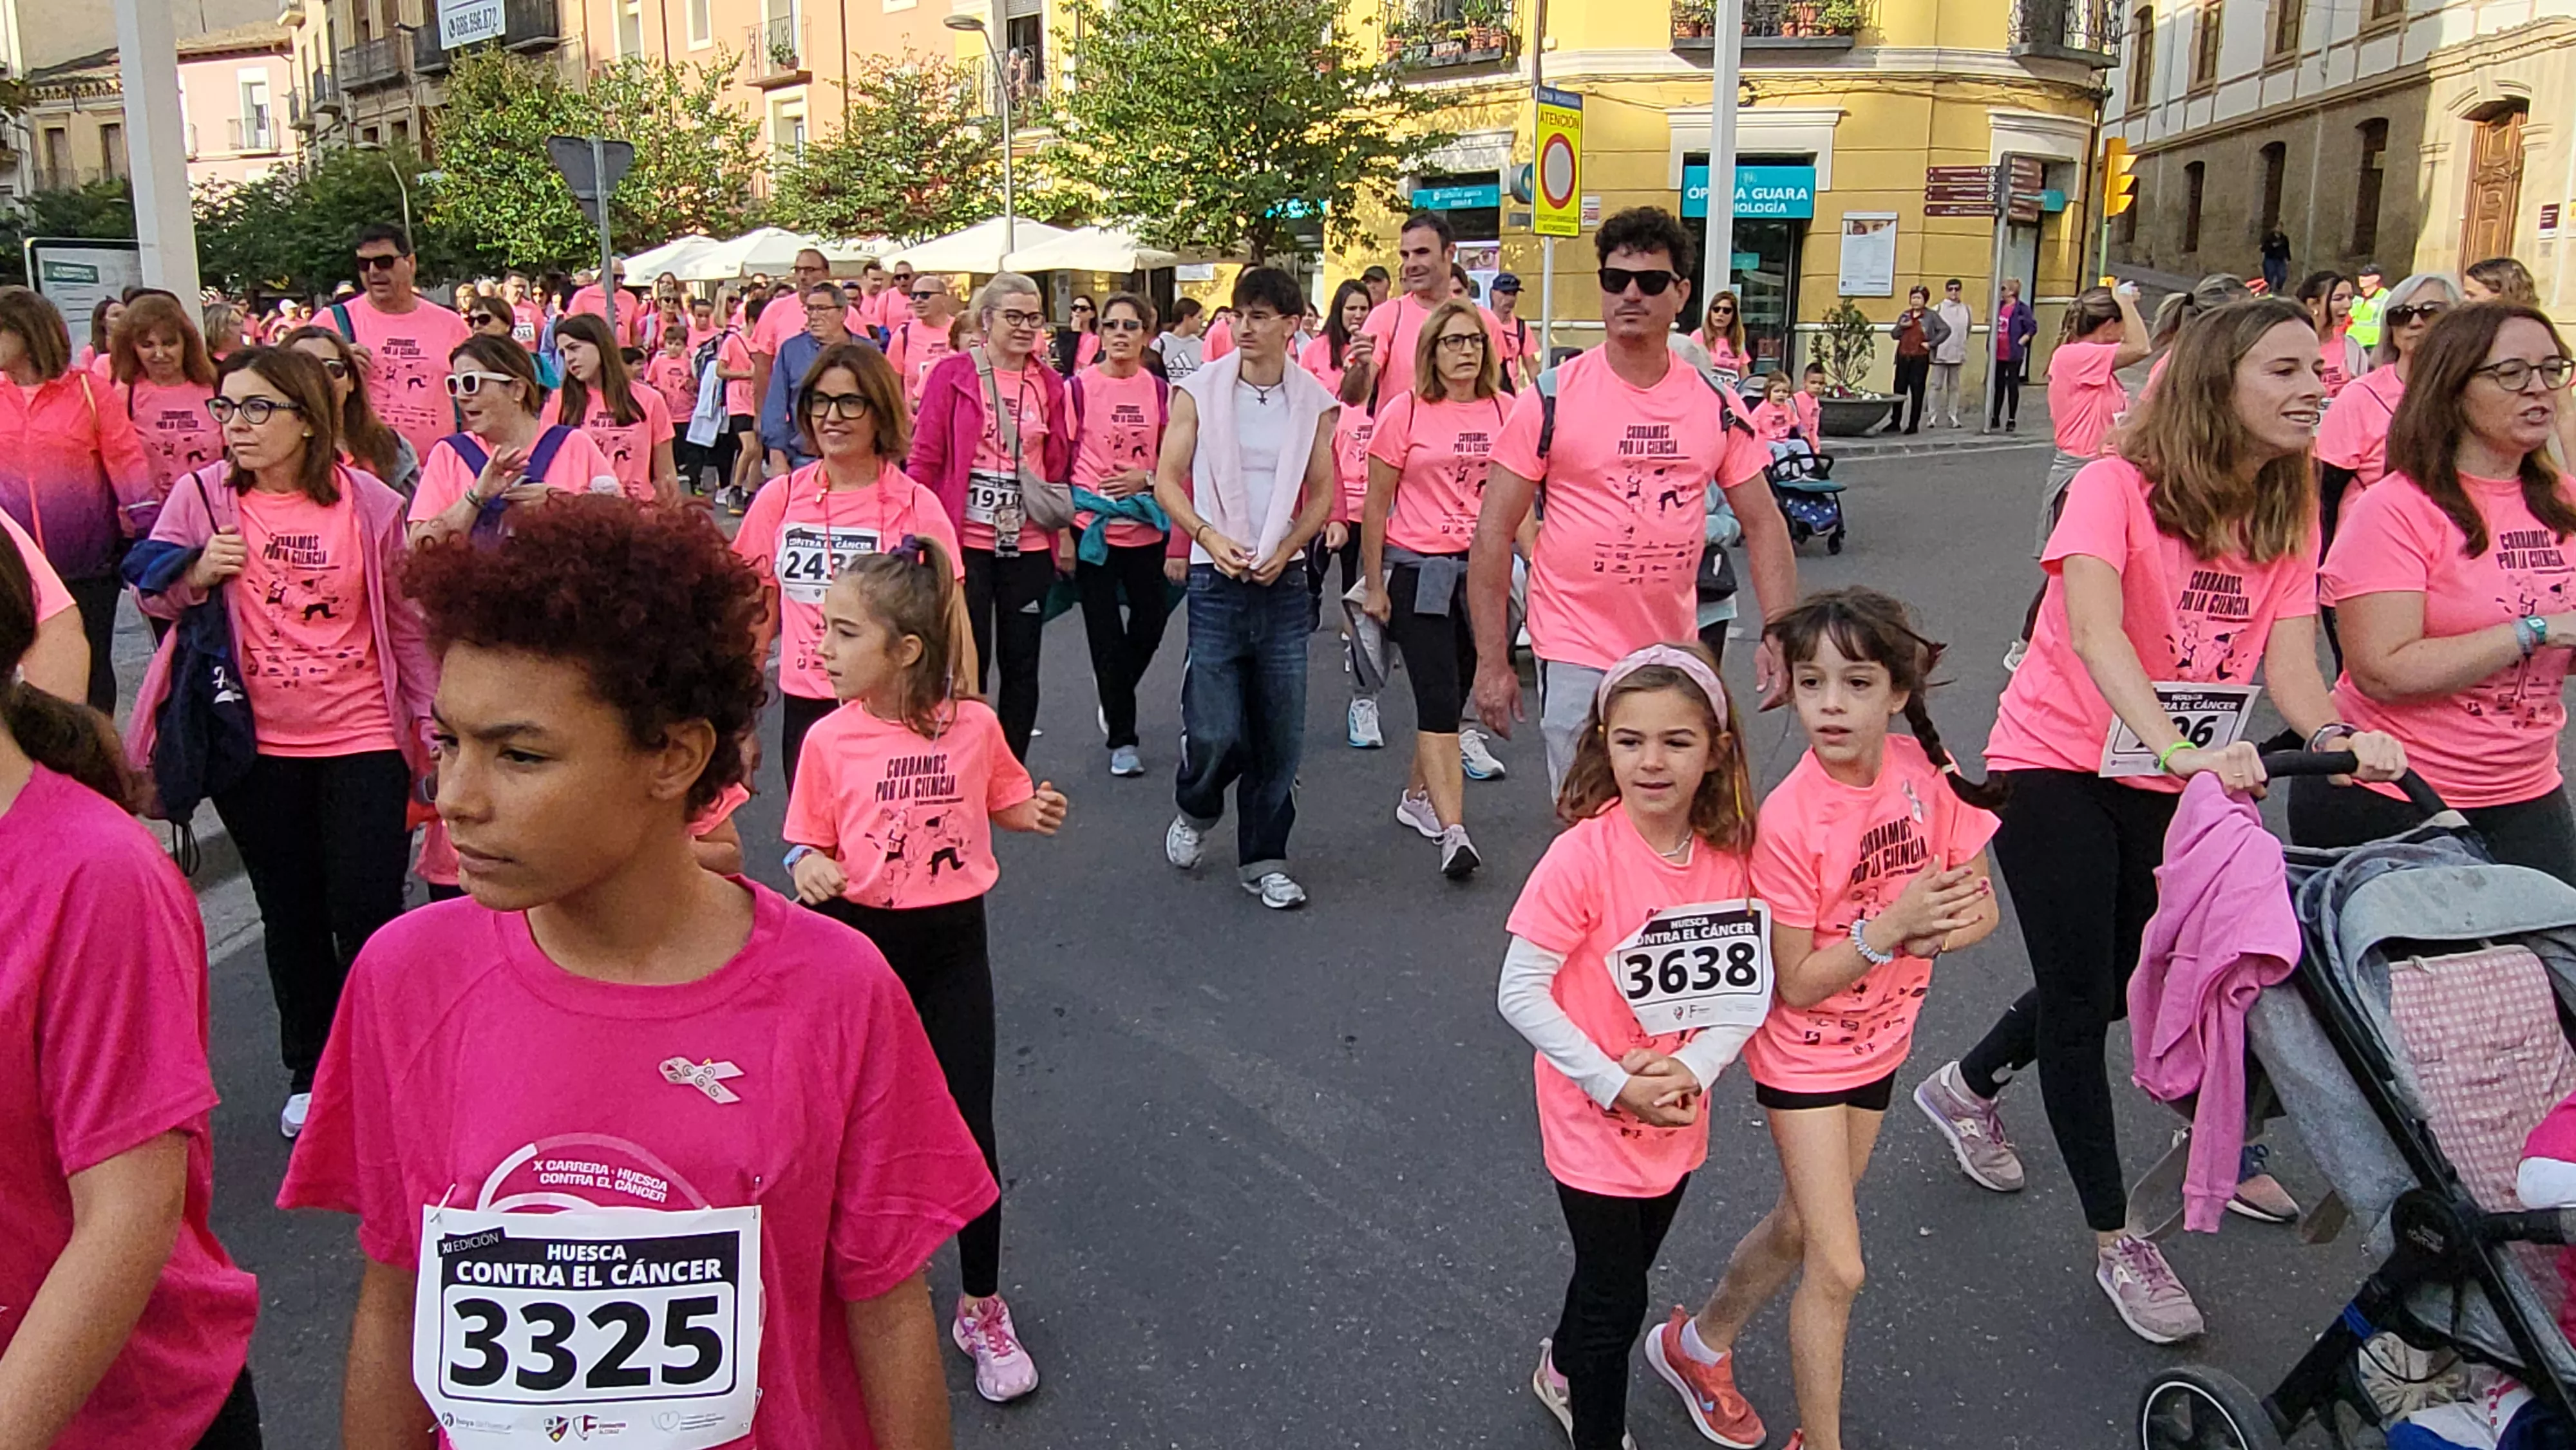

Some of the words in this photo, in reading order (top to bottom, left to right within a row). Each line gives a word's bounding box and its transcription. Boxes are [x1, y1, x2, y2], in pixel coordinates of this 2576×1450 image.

[1687, 184, 1746, 200] ÓPA
[1752, 187, 1808, 200] GUARA
[2496, 551, 2516, 570] POR
[2518, 551, 2528, 569] LA
[2190, 570, 2242, 594] CORRAMOS
[2177, 590, 2195, 611] POR
[2193, 592, 2208, 612] LA
[2208, 594, 2249, 616] CIENCIA
[2193, 699, 2238, 710] CÁNCER
[887, 754, 947, 779] CORRAMOS
[876, 780, 896, 803] POR
[899, 778, 911, 800] LA
[914, 775, 956, 798] CIENCIA
[1883, 836, 1927, 871] CIENCIA
[1637, 932, 1680, 945] ONTRA
[1683, 928, 1698, 940] EL
[1701, 922, 1756, 938] CÁNCER
[1671, 917, 1709, 930] HUESCA
[1624, 941, 1757, 1000] 3638
[533, 1161, 544, 1171] X
[546, 1160, 609, 1175] CARRERA
[617, 1167, 668, 1192] HUESCA
[540, 1173, 594, 1187] CONTRA
[596, 1177, 612, 1189] EL
[453, 1232, 500, 1254] EDICIÓN
[547, 1244, 627, 1261] HUESCA
[456, 1261, 565, 1286] CONTRA
[573, 1265, 603, 1287] EL
[610, 1258, 723, 1286] CÁNCER
[450, 1295, 723, 1391] 3325
